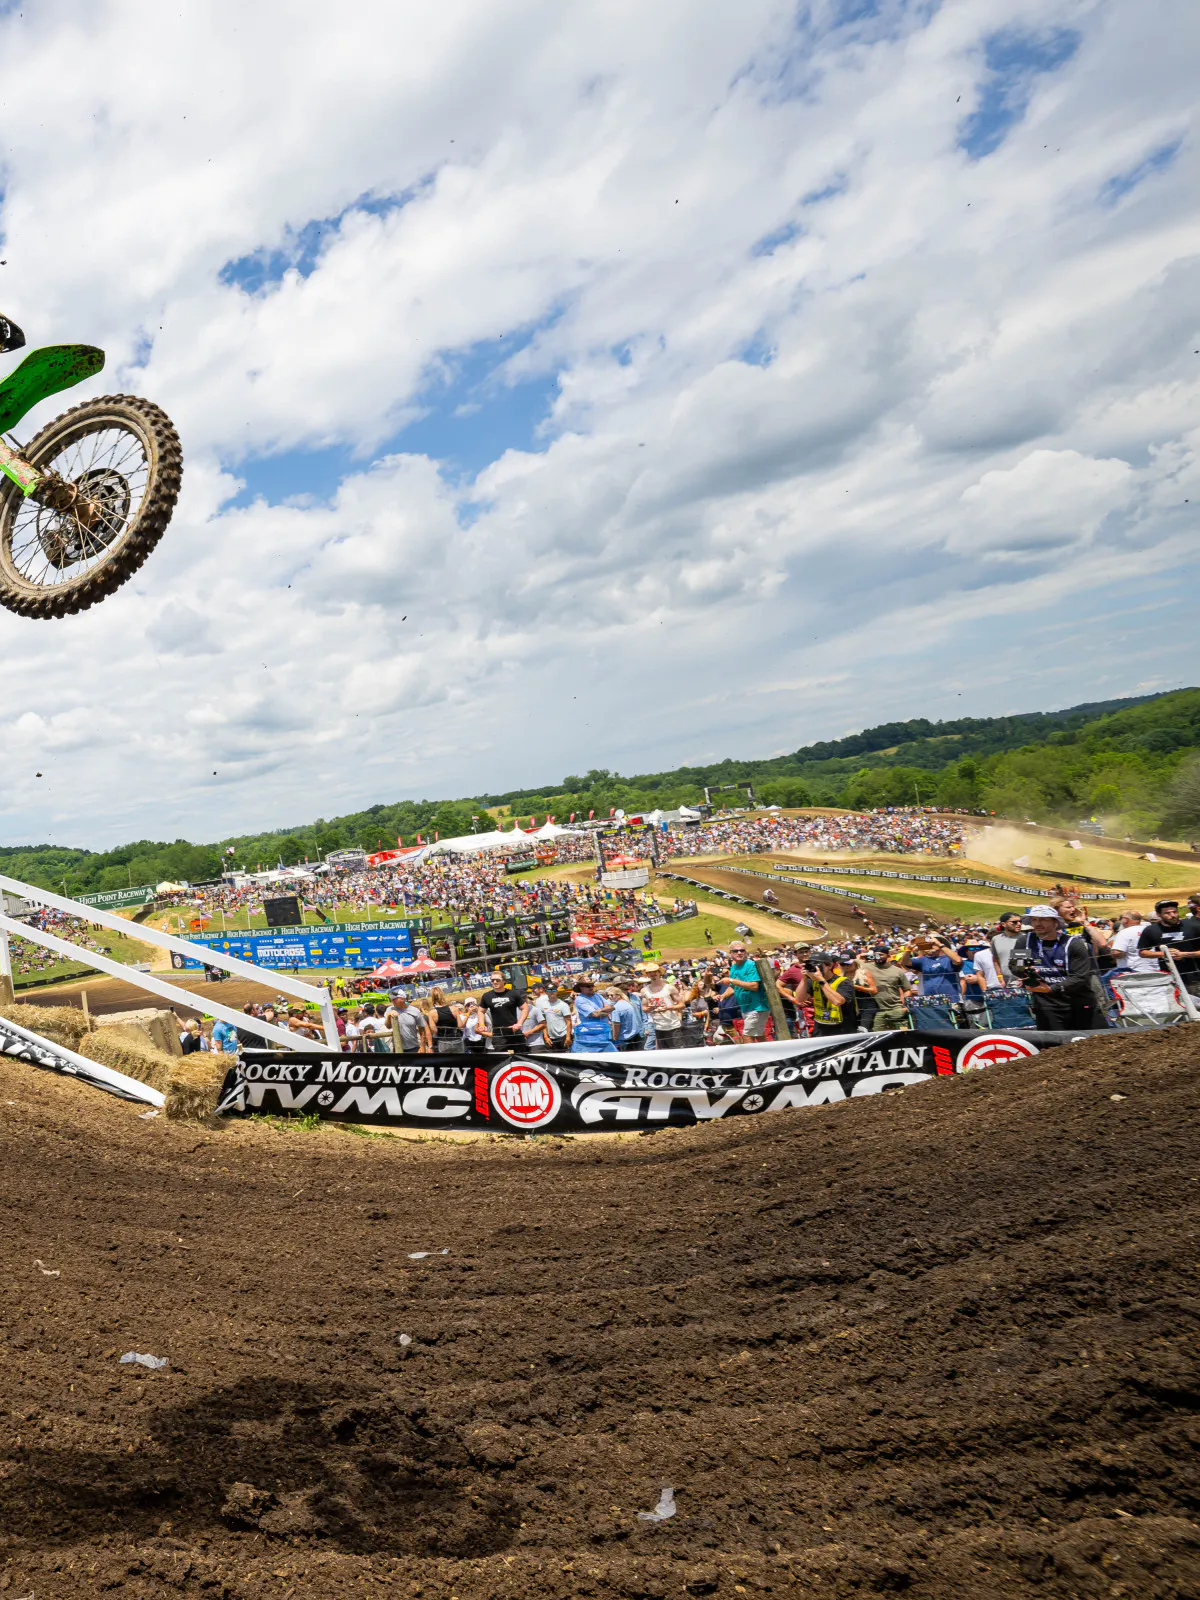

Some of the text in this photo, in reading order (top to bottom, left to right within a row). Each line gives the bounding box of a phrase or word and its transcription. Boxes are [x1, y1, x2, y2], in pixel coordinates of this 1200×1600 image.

[79, 888, 147, 906] HIGH POINT RACEWAY
[226, 930, 239, 938] HIGH
[252, 928, 274, 937] RACEWAY
[281, 924, 335, 935] HIGH POINT RACEWAY
[345, 921, 407, 932] HIGH POINT RACEWAY
[256, 947, 306, 958] MOTOCROSS
[235, 1060, 471, 1085] ROCKY MOUNTAIN
[622, 1046, 928, 1088] ROCKY MOUNTAIN
[473, 1067, 489, 1121] .com
[506, 1082, 546, 1107] RM
